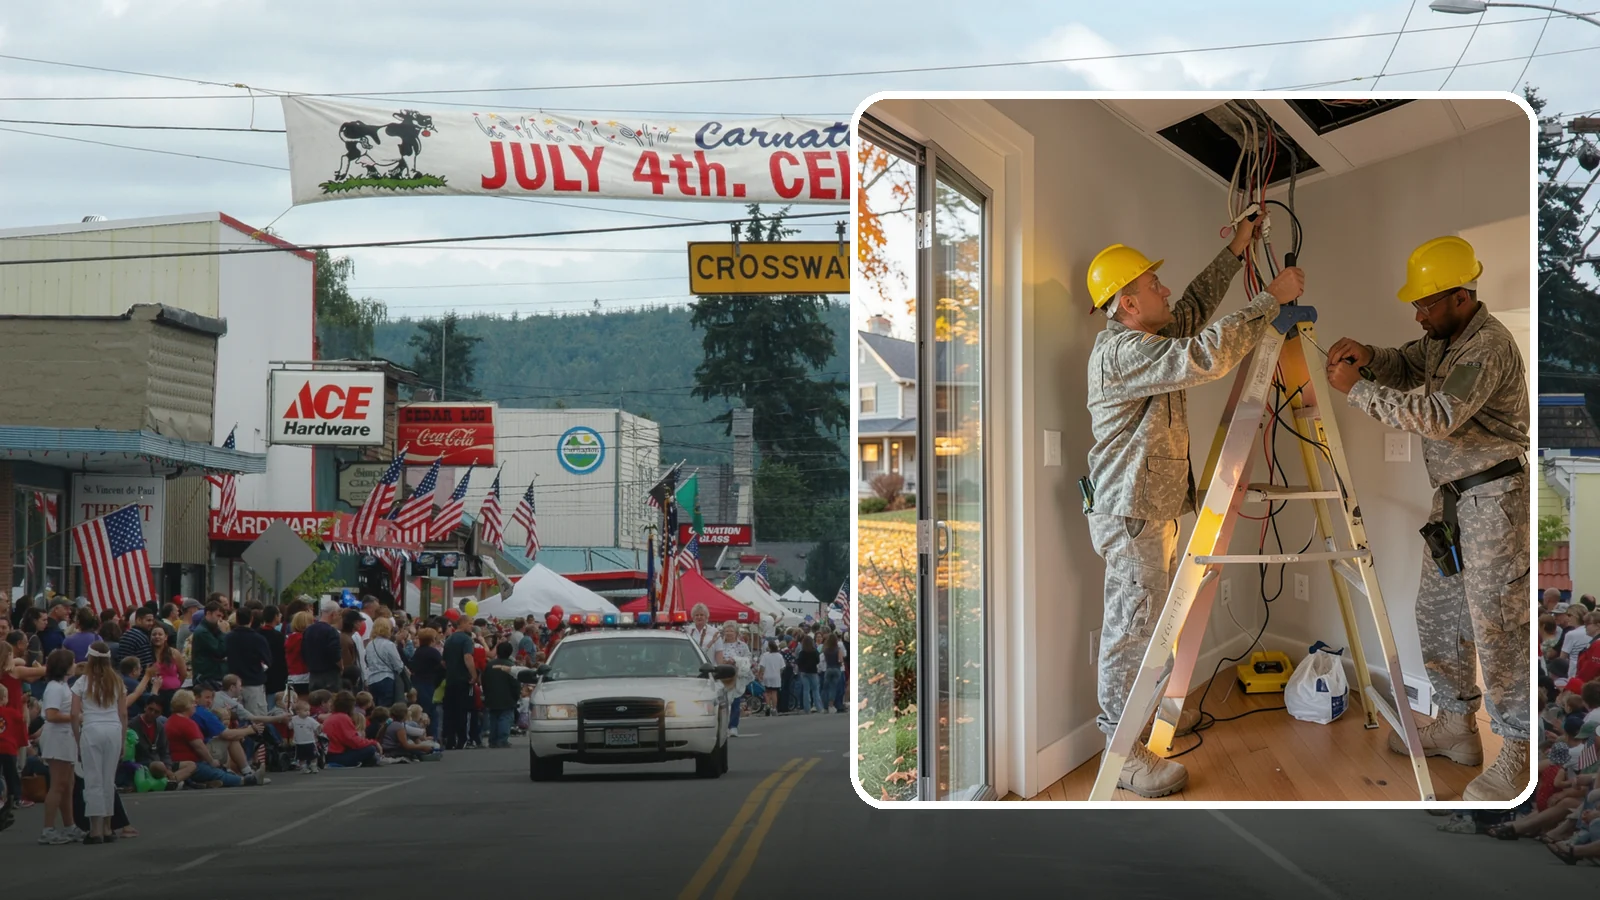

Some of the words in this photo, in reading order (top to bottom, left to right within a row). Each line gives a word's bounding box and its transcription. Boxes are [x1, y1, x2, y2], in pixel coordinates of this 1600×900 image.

[481, 141, 604, 193] JULY
[632, 149, 746, 198] 4th.
[697, 254, 850, 280] CROSSWA
[283, 379, 374, 420] ACE
[405, 409, 452, 421] CEDAR
[283, 420, 371, 437] Hardware
[416, 428, 477, 446] Coca-Cola
[353, 467, 383, 479] Simpl
[96, 484, 124, 495] Vincent
[126, 485, 136, 495] de
[137, 485, 155, 495] Paul
[213, 515, 330, 536] HARDARE
[688, 526, 741, 535] CRNATION
[699, 535, 730, 543] GLASS
